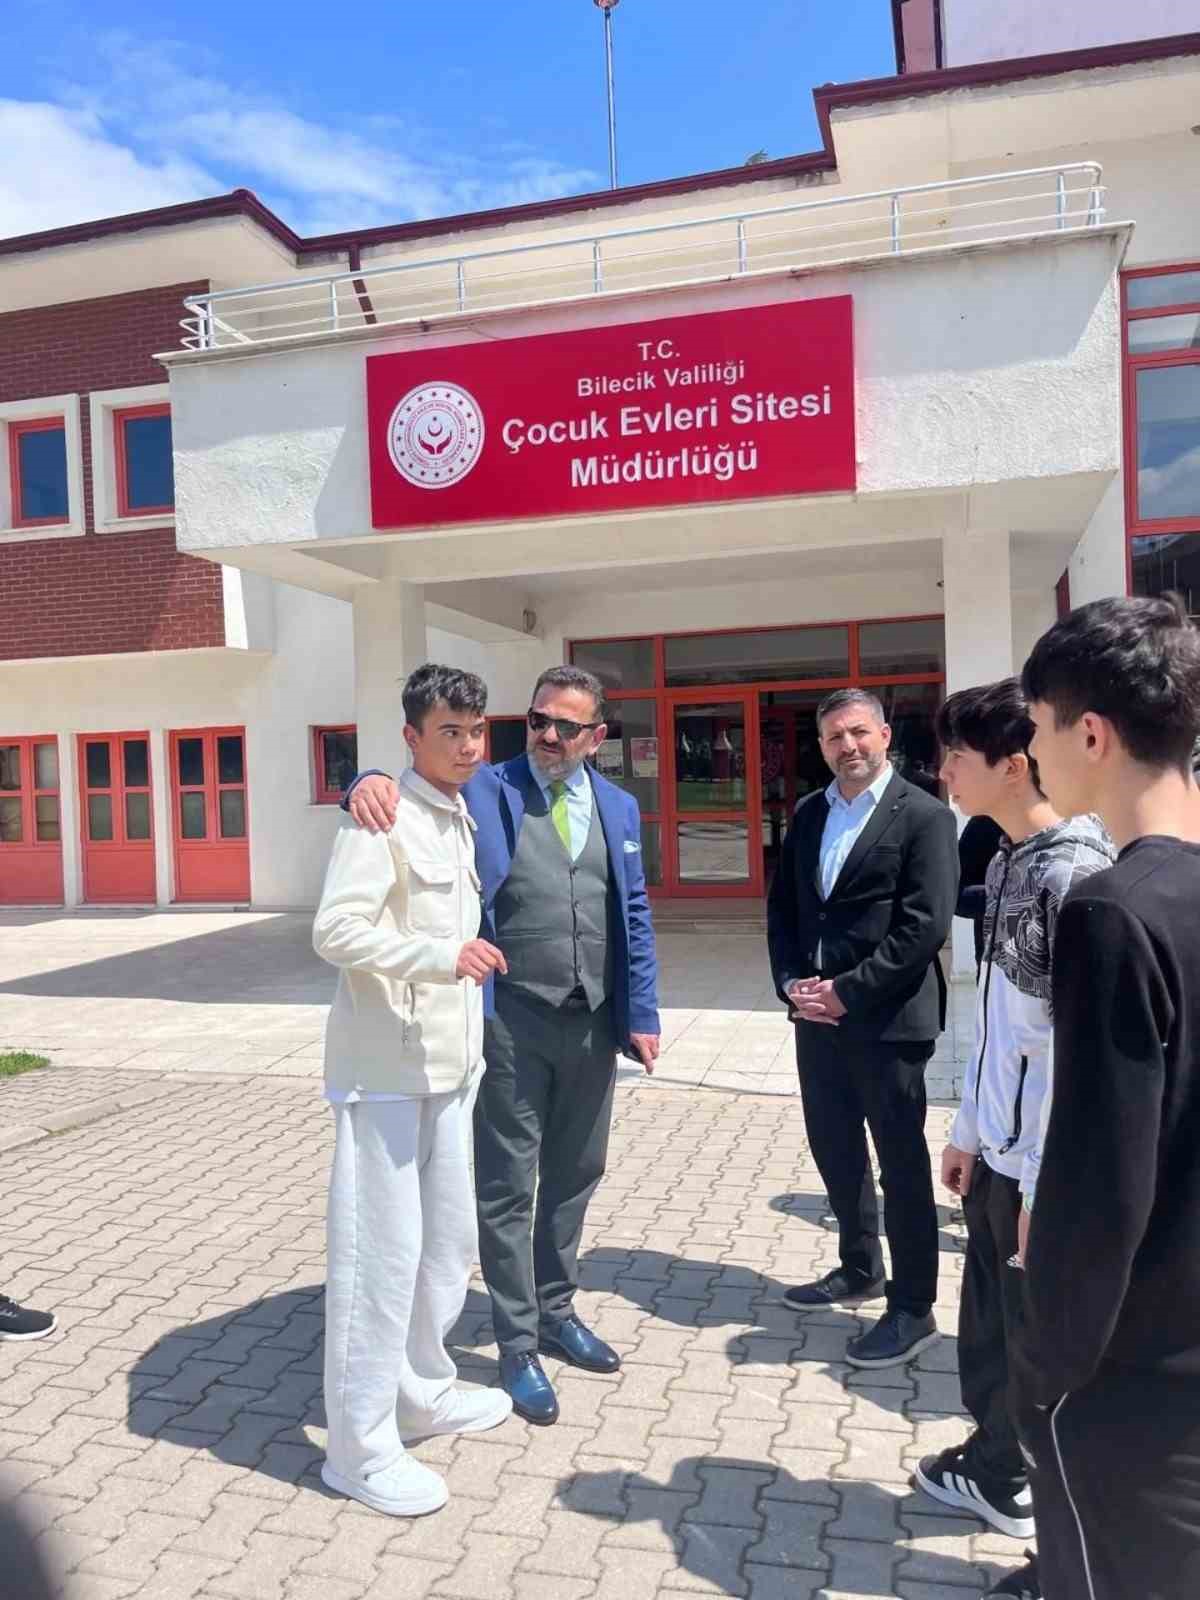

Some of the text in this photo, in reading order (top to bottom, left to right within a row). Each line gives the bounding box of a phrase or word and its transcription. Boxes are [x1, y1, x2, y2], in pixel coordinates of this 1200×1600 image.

[637, 339, 680, 361] T.C.
[577, 359, 745, 397] Bilecik Valiliği
[502, 410, 609, 454] Çocuk
[620, 397, 718, 436] Evleri
[730, 385, 832, 425] Sitesi
[571, 441, 758, 488] Müdürlüğü
